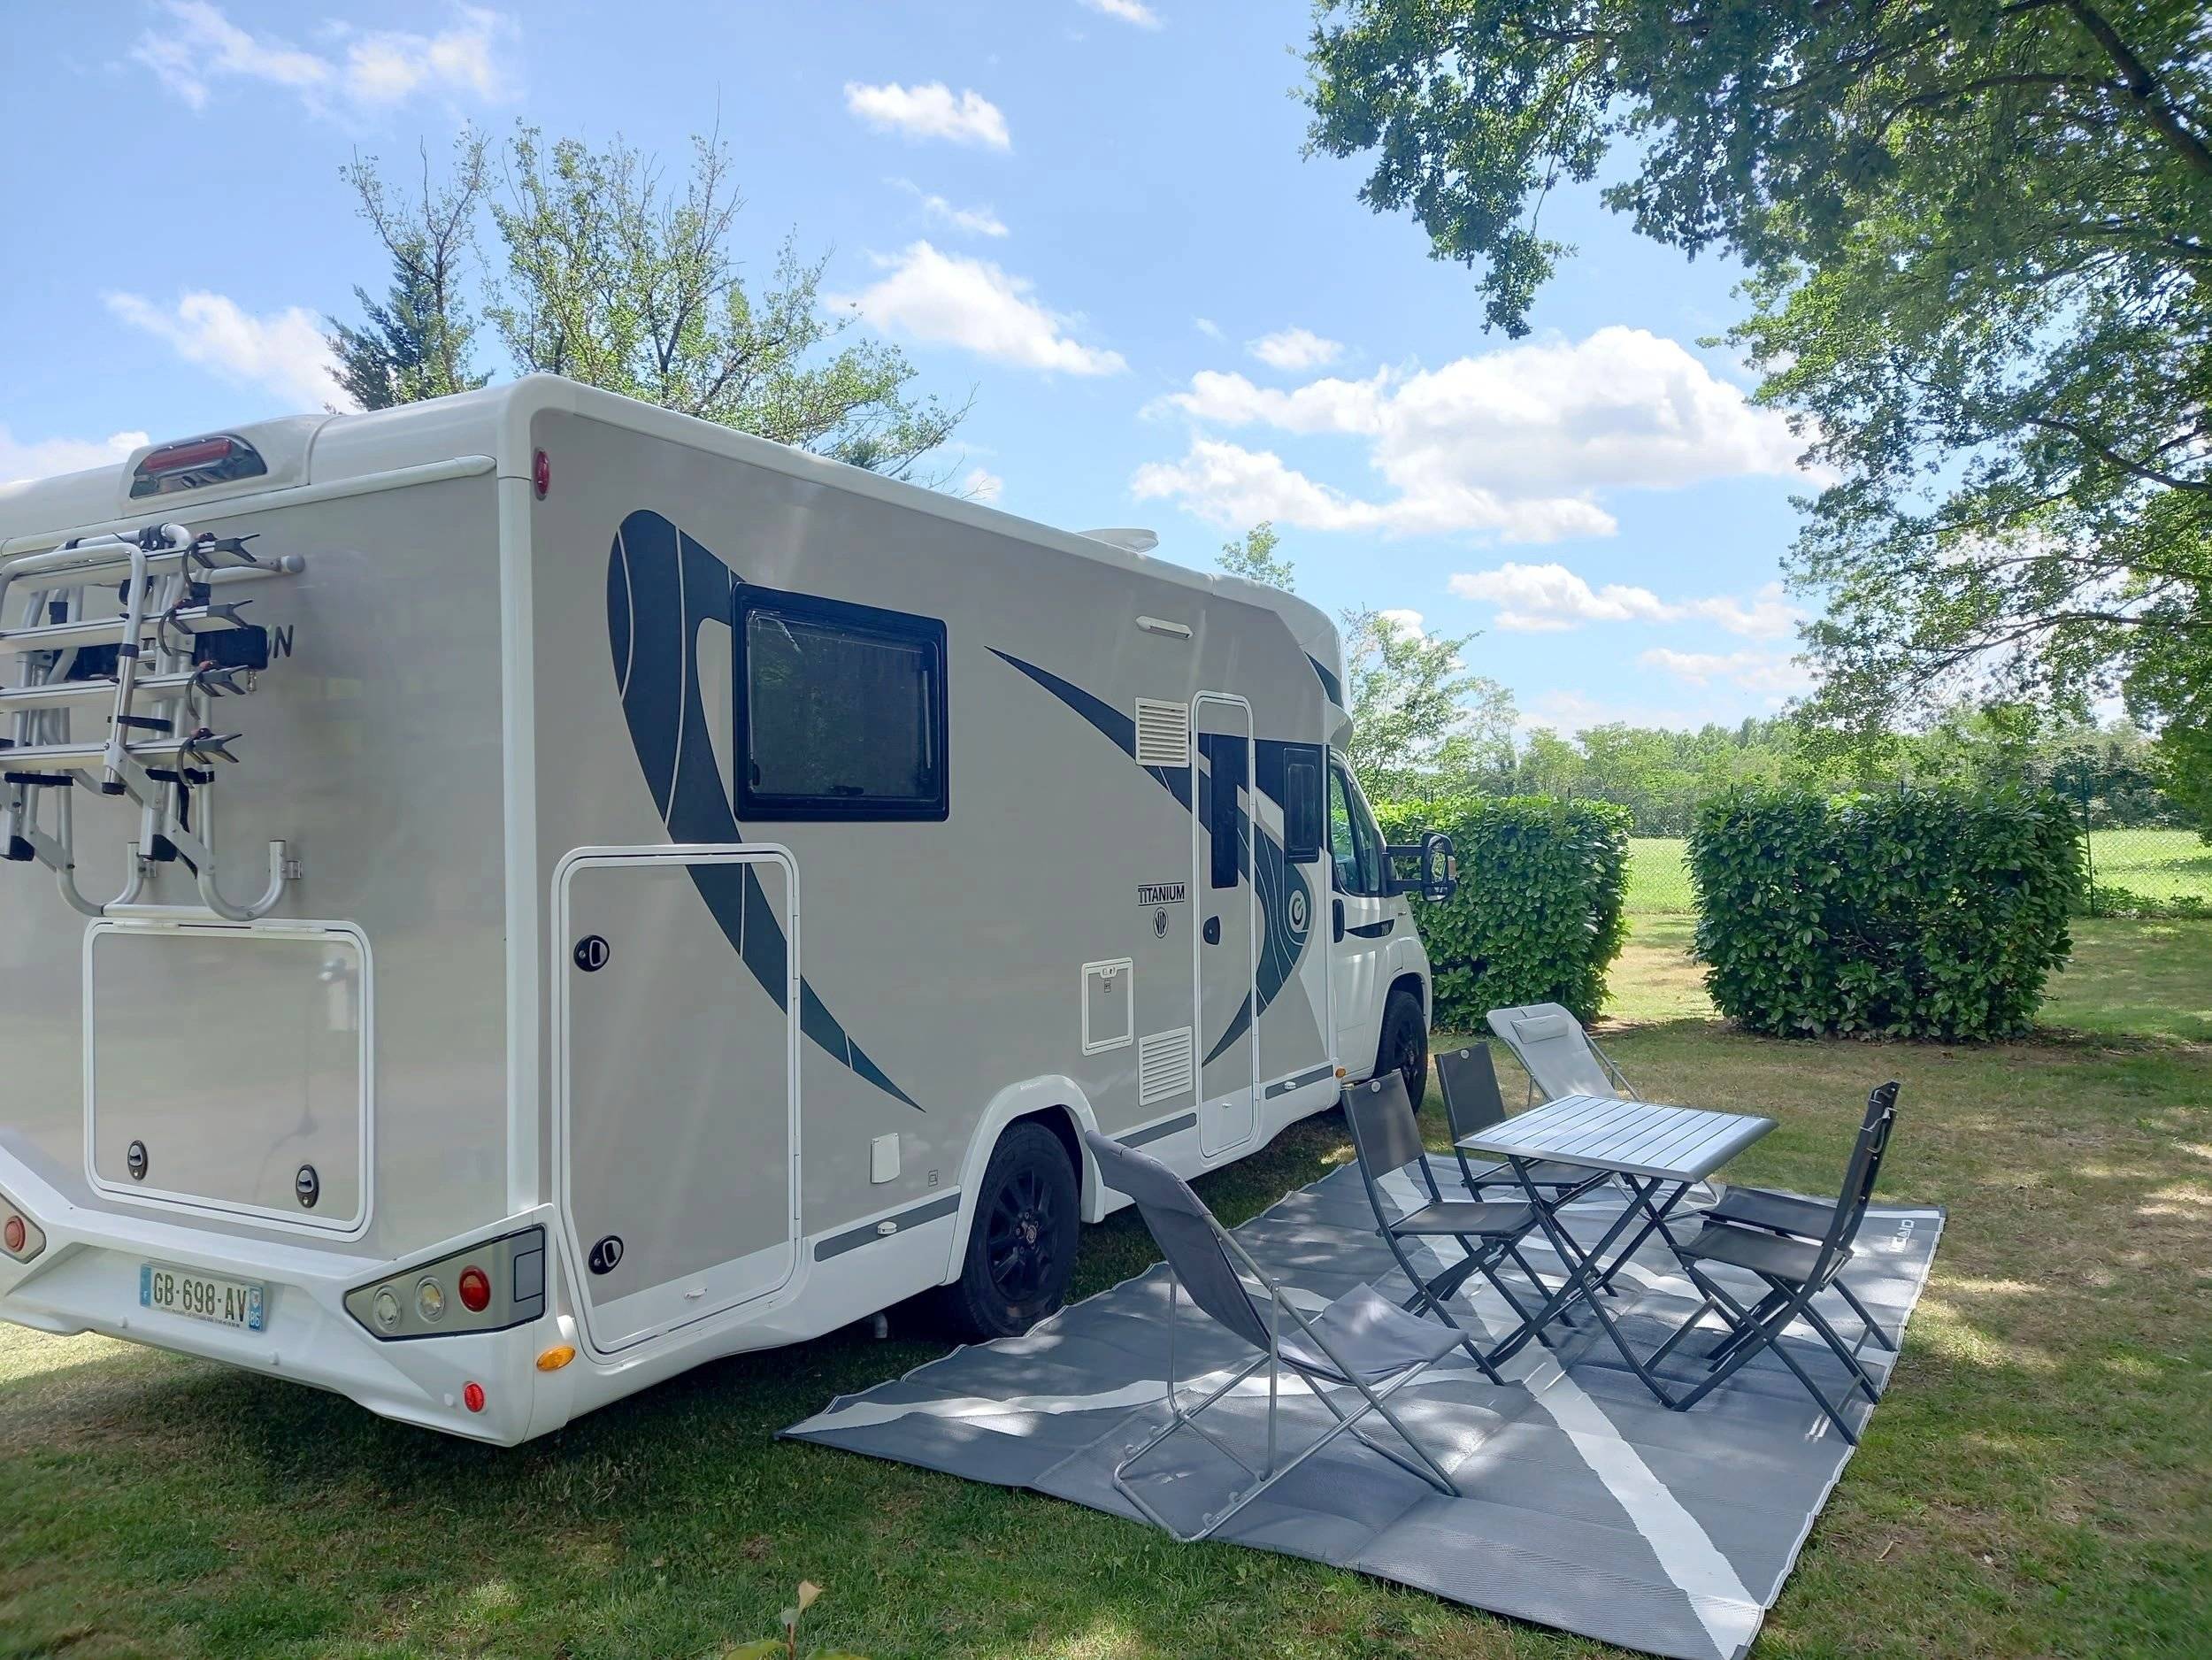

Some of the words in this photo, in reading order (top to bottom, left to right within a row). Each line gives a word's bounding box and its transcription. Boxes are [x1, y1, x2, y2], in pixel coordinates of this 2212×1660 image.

[1138, 885, 1185, 903] TITANIUM
[154, 1272, 247, 1322] GB-698-AV
[250, 1310, 260, 1327] 86
